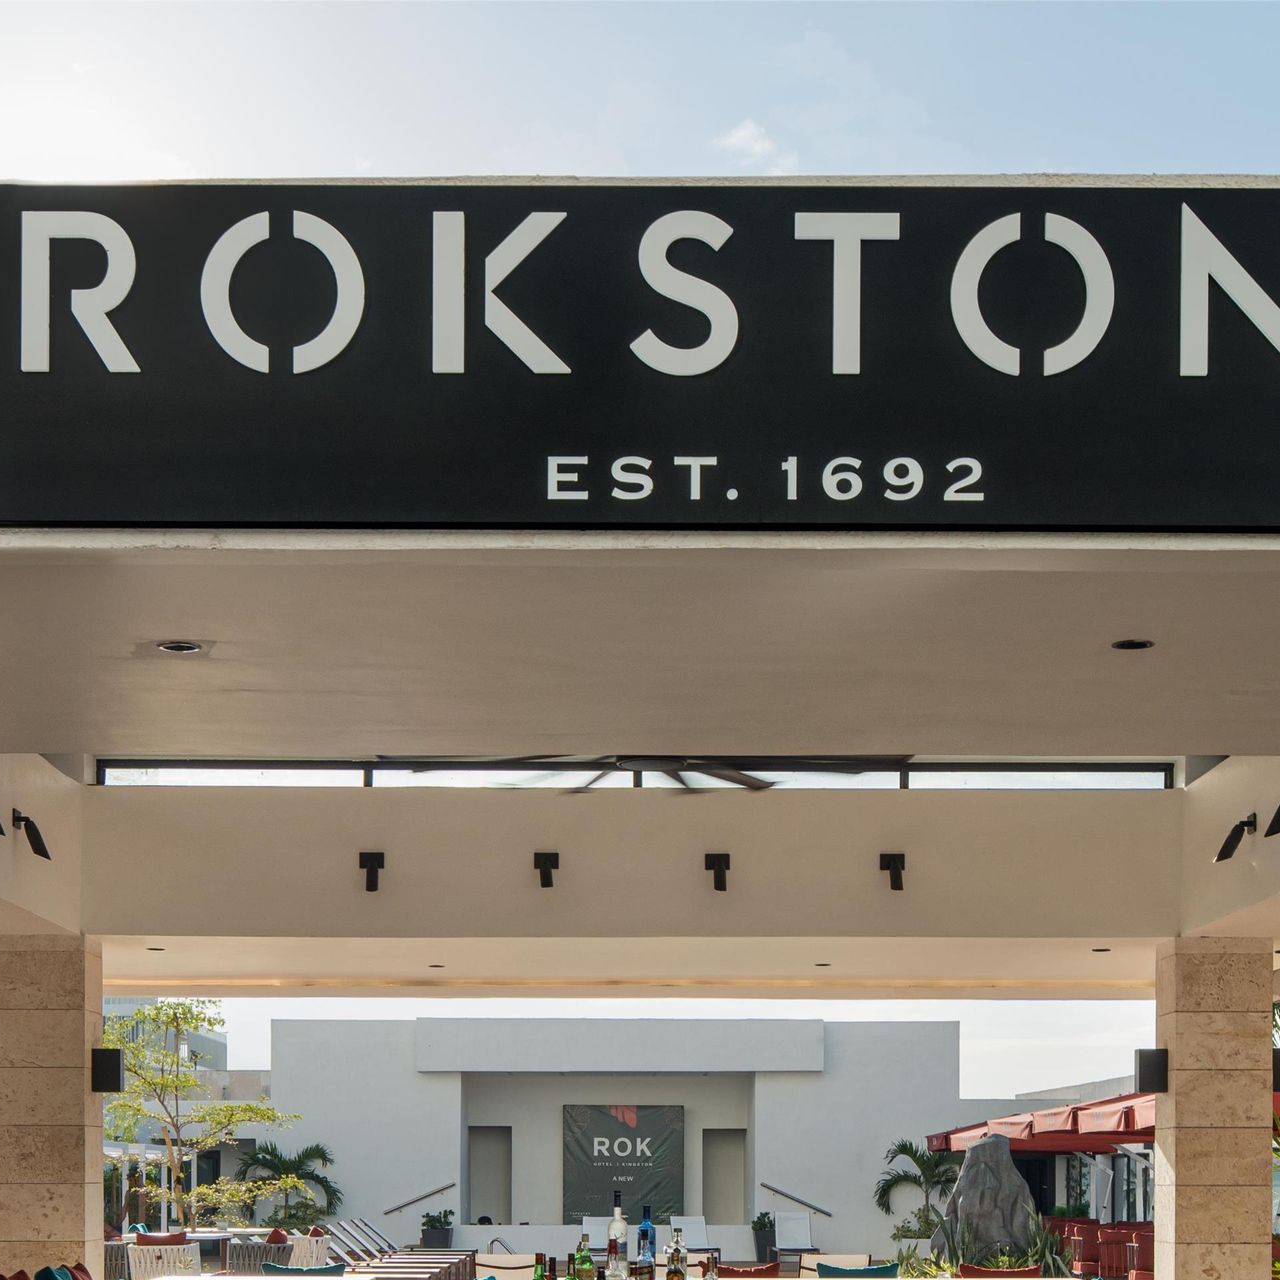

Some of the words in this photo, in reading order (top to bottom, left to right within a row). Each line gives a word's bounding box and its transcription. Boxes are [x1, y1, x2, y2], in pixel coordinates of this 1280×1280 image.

[546, 456, 739, 502] EST.
[781, 456, 986, 502] 1692
[593, 1137, 653, 1157] ROK
